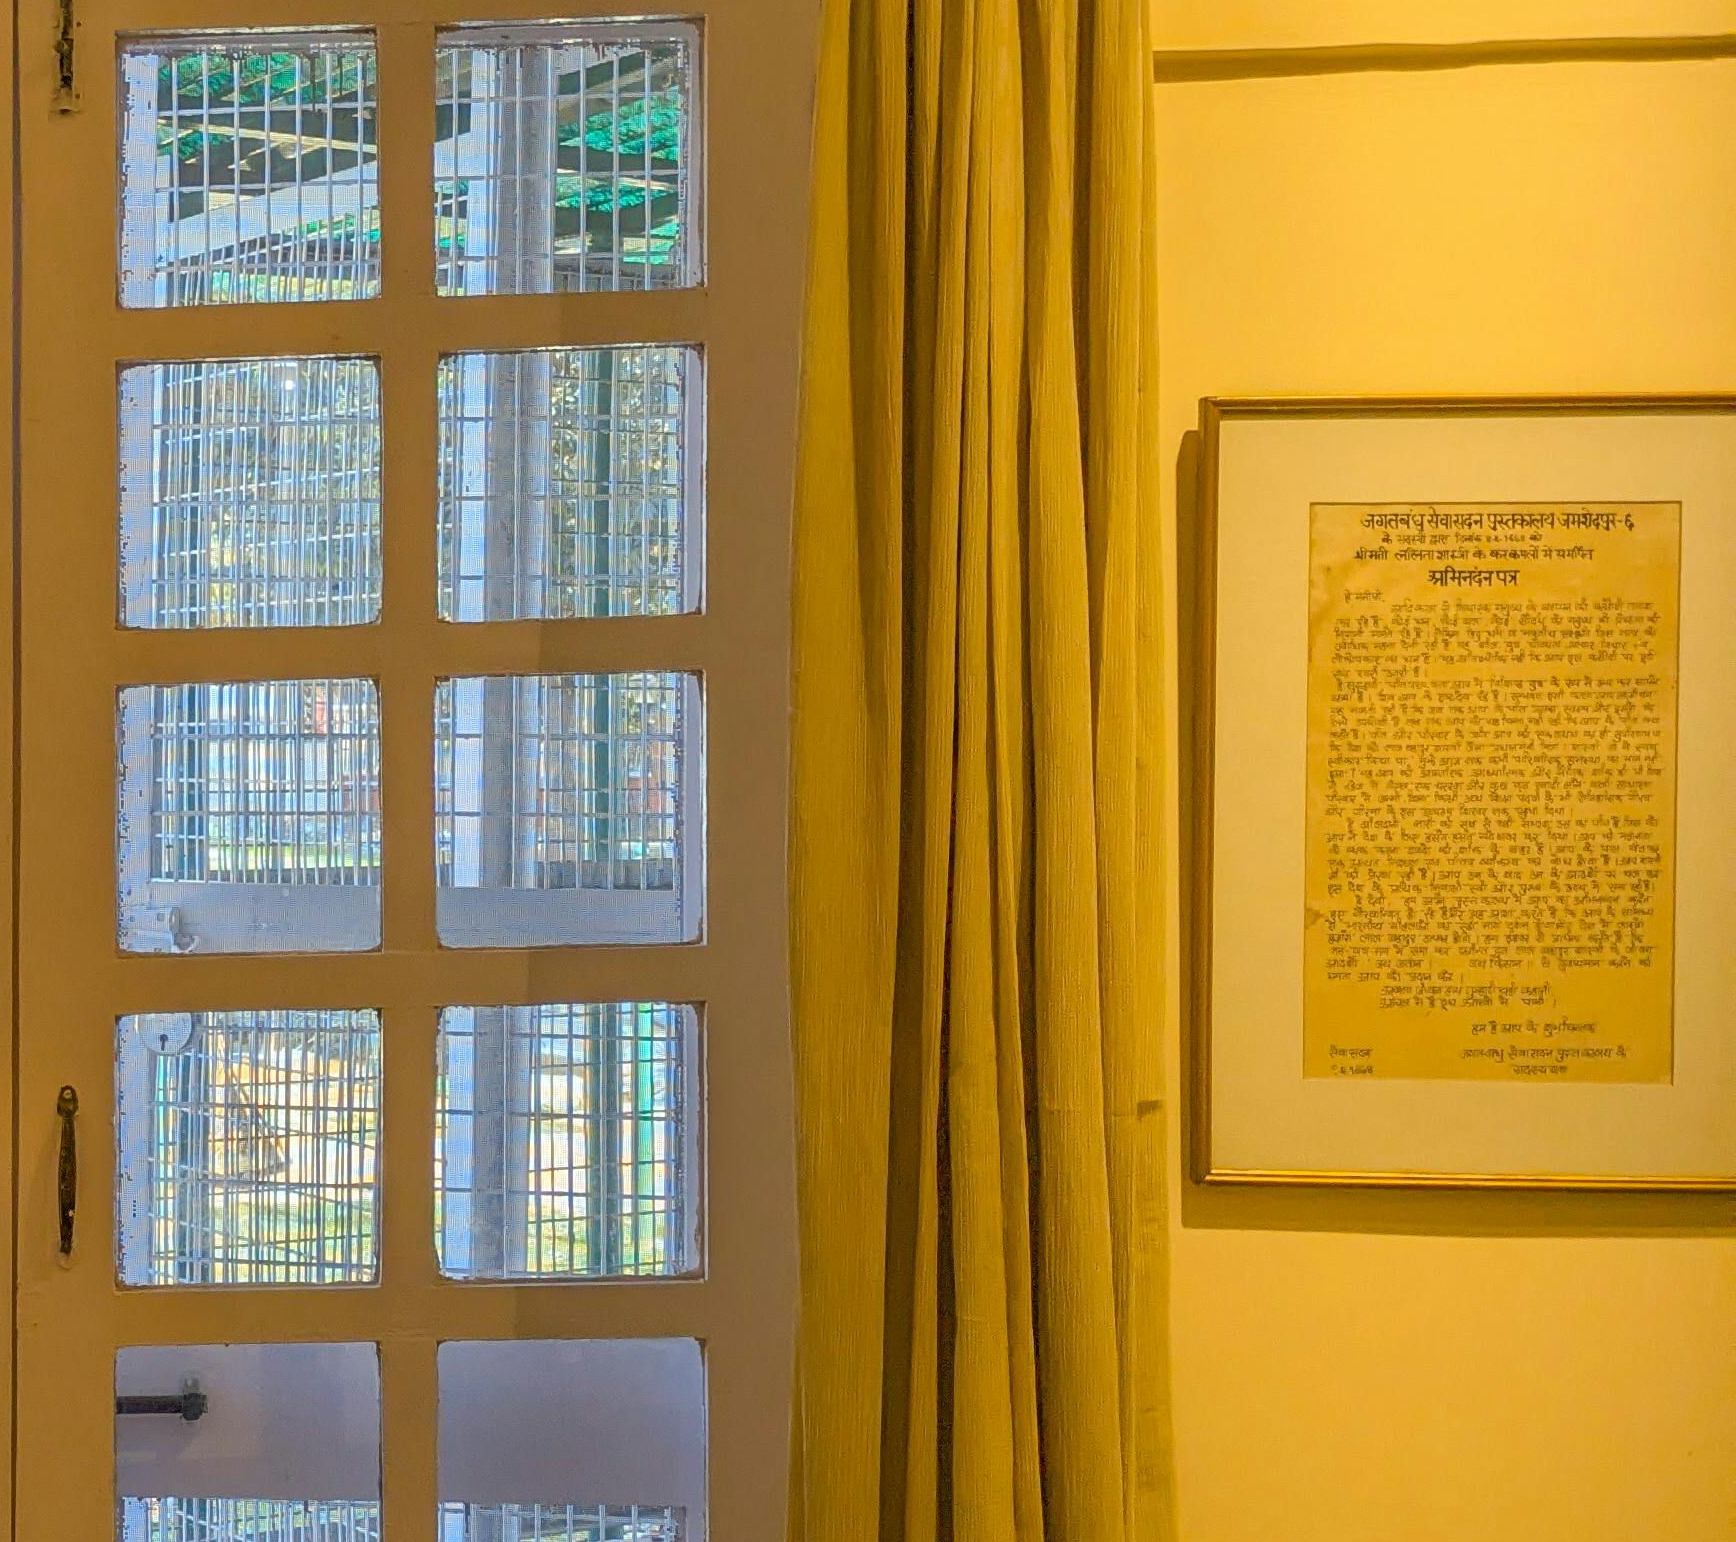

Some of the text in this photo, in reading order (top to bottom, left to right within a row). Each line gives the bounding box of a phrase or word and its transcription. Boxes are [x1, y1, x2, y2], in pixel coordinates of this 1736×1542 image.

[1427, 507, 1483, 530] सेवासदन
[1487, 512, 1554, 531] पुस्तकालय
[1472, 547, 1486, 558] के
[1496, 569, 1520, 586] पत्र
